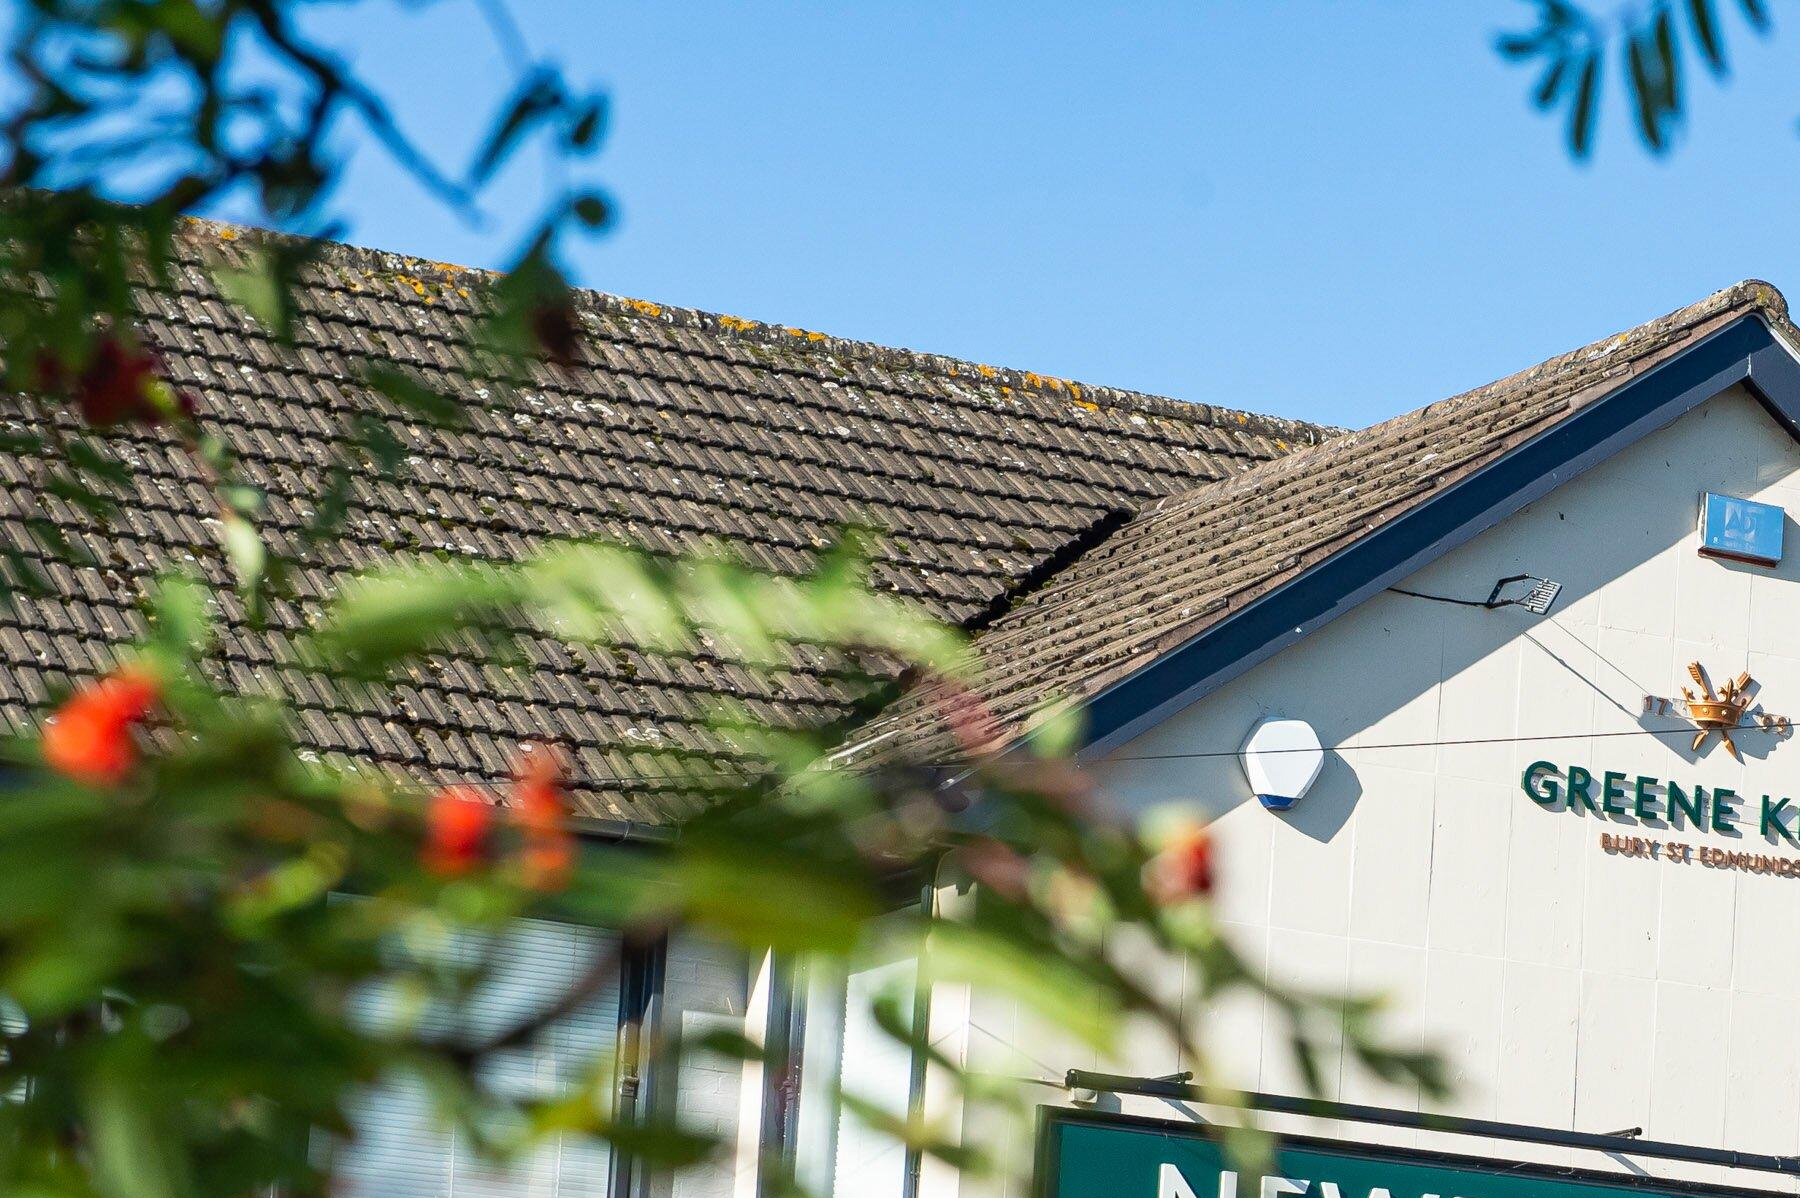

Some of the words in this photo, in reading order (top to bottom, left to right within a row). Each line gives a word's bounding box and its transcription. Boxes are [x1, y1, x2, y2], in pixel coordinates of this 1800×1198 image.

[1523, 760, 1736, 833] GREENE
[1601, 832, 1656, 858] BURY
[1666, 841, 1690, 860] ST
